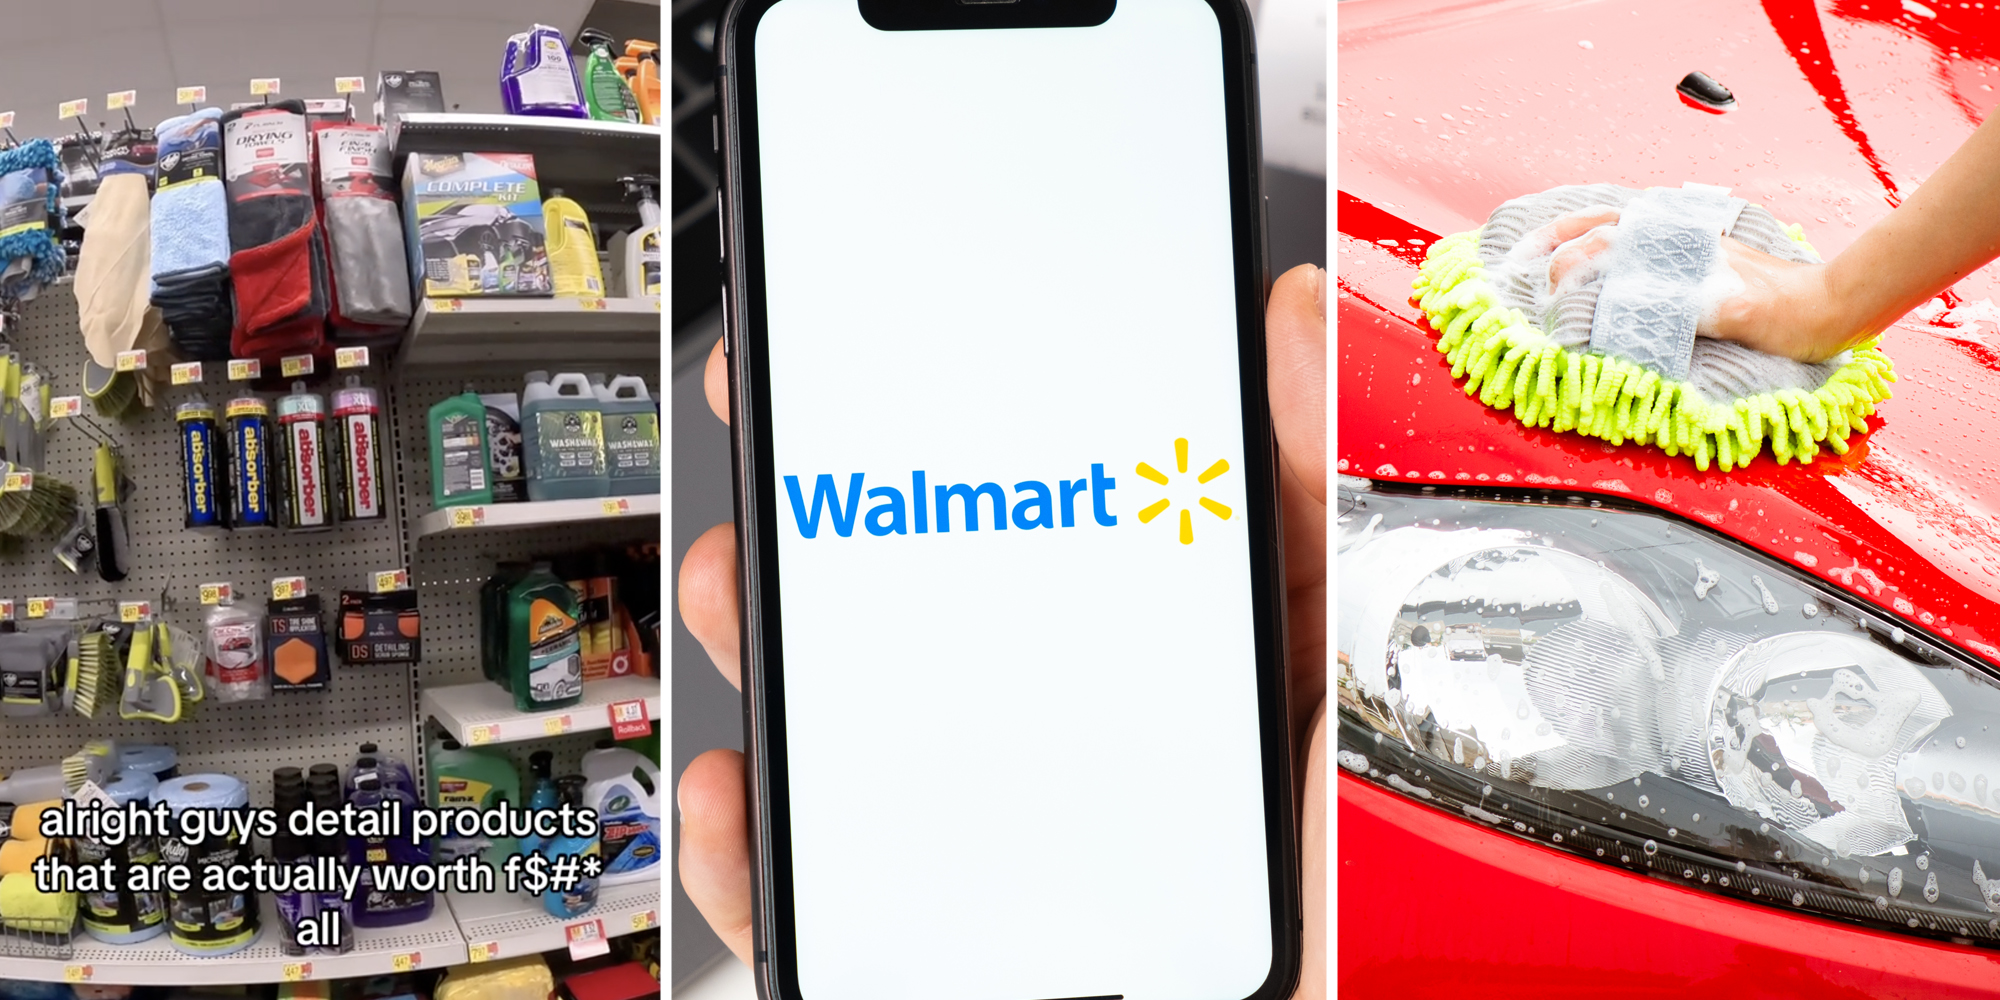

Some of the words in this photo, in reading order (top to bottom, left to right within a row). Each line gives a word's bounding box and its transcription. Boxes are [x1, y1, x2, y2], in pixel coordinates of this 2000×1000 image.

[236, 132, 293, 146] DRYING
[426, 180, 526, 193] COMPLETE
[498, 194, 519, 202] KIT
[296, 402, 311, 412] XL
[608, 440, 654, 450] WASH&WAX
[190, 430, 206, 514] absorber
[244, 426, 261, 513] absorber
[298, 428, 316, 518] absorber
[354, 421, 372, 510] absorber
[783, 463, 1117, 539] Walmart
[342, 595, 350, 605] 2
[272, 618, 286, 633] TS
[352, 644, 368, 659] DS
[374, 642, 410, 652] DETAILING
[618, 724, 646, 734] Rollback
[604, 826, 628, 841] ZIP
